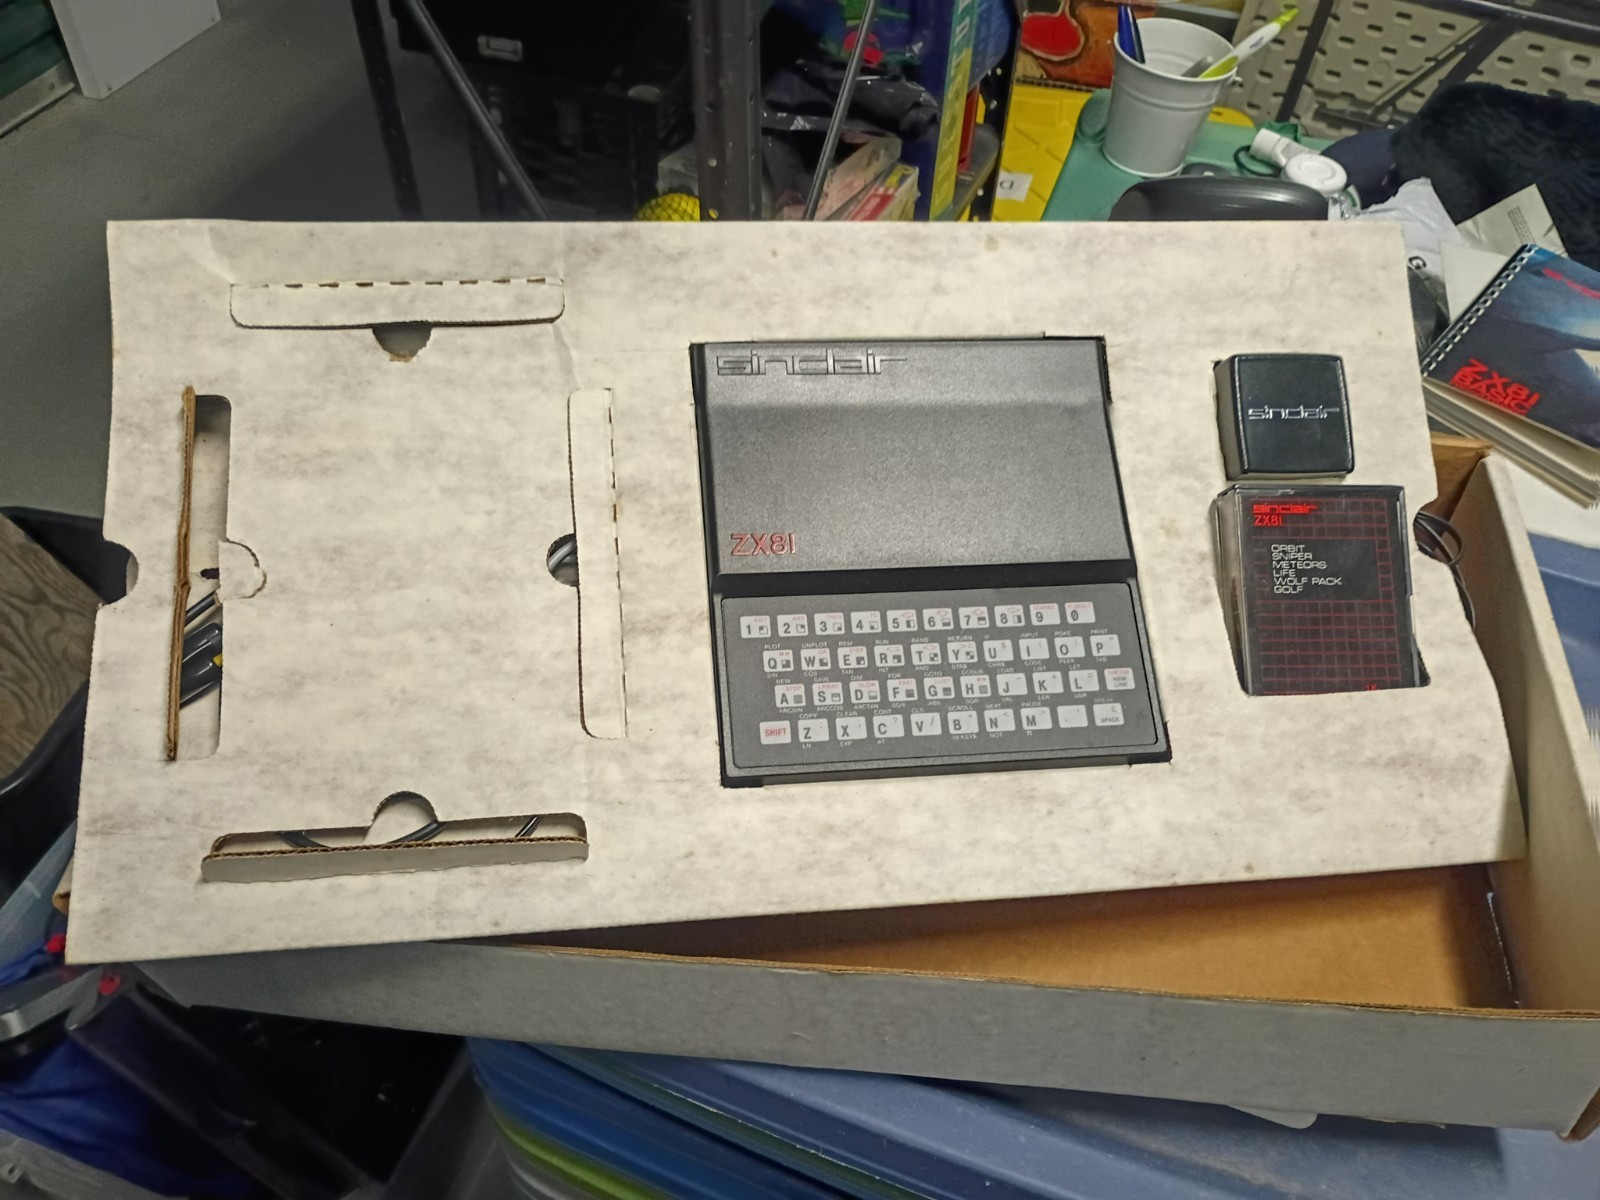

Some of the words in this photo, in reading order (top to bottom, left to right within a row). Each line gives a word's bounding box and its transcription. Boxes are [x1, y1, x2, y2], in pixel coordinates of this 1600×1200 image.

[717, 348, 908, 376] sinclair
[1462, 358, 1541, 405] ZX81
[1454, 370, 1531, 413] BASIC
[1248, 405, 1340, 420] sinclair
[1253, 503, 1317, 513] sinclair
[1254, 515, 1282, 526] ZX81
[730, 532, 796, 556] ZX81
[1272, 561, 1327, 569] METEORS
[1273, 569, 1296, 577] LIFE
[928, 616, 936, 627] 6
[964, 615, 970, 625] 7
[1000, 614, 1008, 624] 8
[1036, 612, 1043, 622] 9
[784, 623, 790, 634] 2
[820, 621, 827, 632] 3
[856, 620, 863, 630] 4
[892, 618, 899, 628] 5
[746, 625, 751, 635] 1
[988, 648, 996, 658] U
[1060, 644, 1068, 655] O
[1096, 643, 1103, 653] P
[880, 653, 888, 664] R
[916, 651, 923, 662] T
[952, 649, 960, 660] Y
[768, 658, 777, 669] Q
[804, 657, 816, 667] W
[843, 655, 850, 666] E
[966, 684, 974, 694] H
[1003, 682, 1009, 693] J
[1038, 680, 1047, 691] K
[1074, 678, 1082, 689] L
[855, 690, 863, 700] D
[893, 687, 899, 698] F
[928, 685, 937, 696] G
[781, 694, 788, 704] A
[818, 691, 826, 702] S
[953, 720, 961, 730] B
[989, 718, 998, 728] N
[1026, 715, 1036, 726] M
[765, 728, 787, 736] SHIFT
[841, 725, 849, 737] X
[878, 723, 887, 734] C
[916, 721, 923, 732] V
[803, 728, 811, 739] Z
